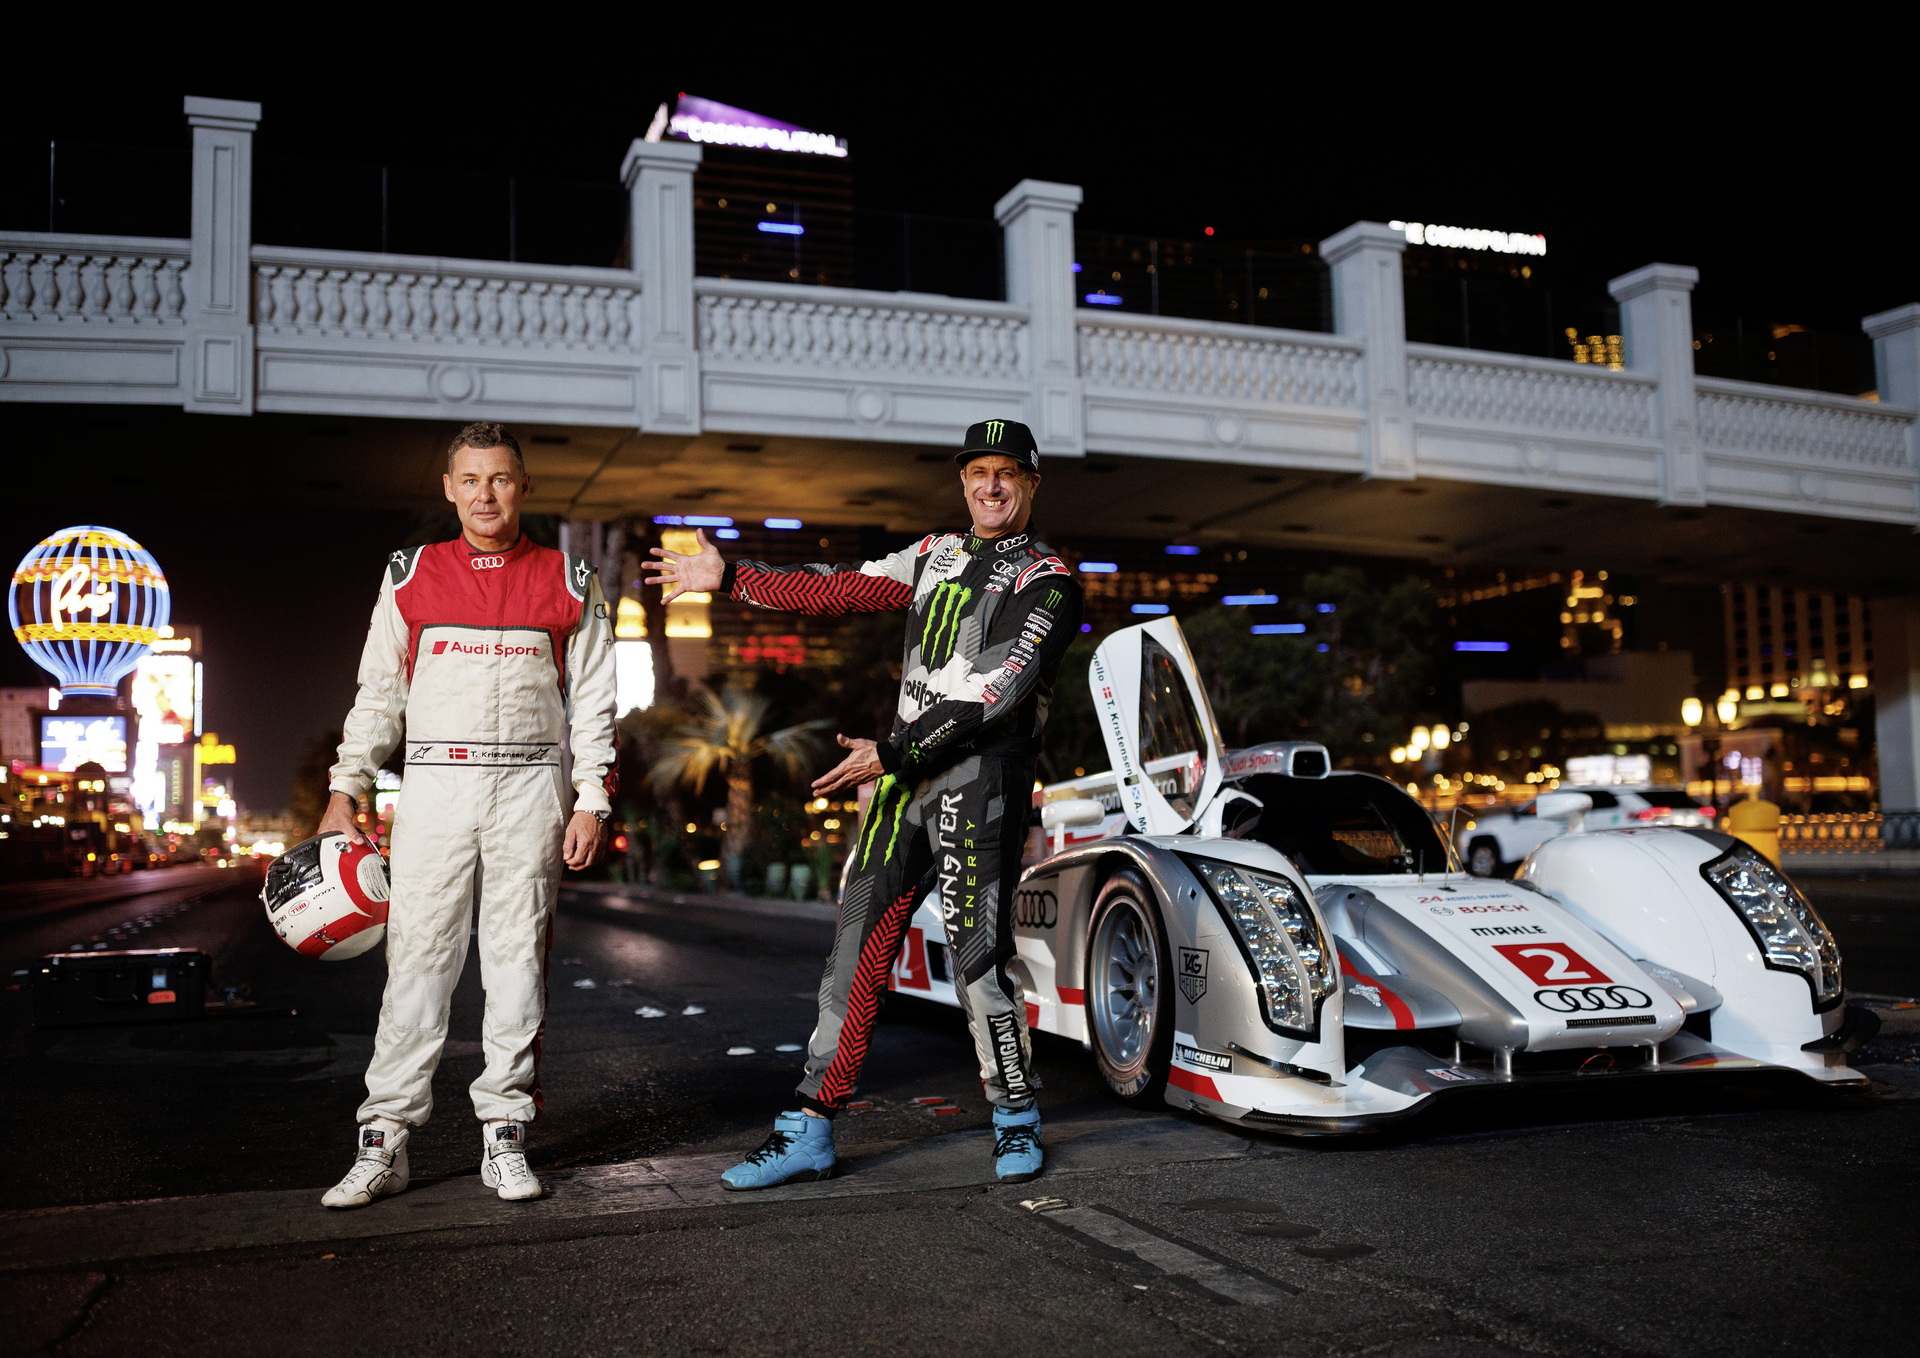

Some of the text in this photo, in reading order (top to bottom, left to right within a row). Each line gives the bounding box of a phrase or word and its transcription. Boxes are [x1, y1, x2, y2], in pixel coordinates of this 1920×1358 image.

[450, 641, 540, 657] Audi Sport
[1109, 711, 1133, 777] Kristensen
[481, 750, 525, 758] Kristensen
[1417, 895, 1444, 904] 24
[290, 902, 308, 915] BELL
[1458, 904, 1529, 914] BOSCH
[1470, 925, 1547, 937] MAHLE
[1183, 952, 1203, 975] TAG
[1517, 947, 1592, 981] 2
[1181, 978, 1204, 1000] HEUER
[1183, 1049, 1231, 1069] MICHELIN
